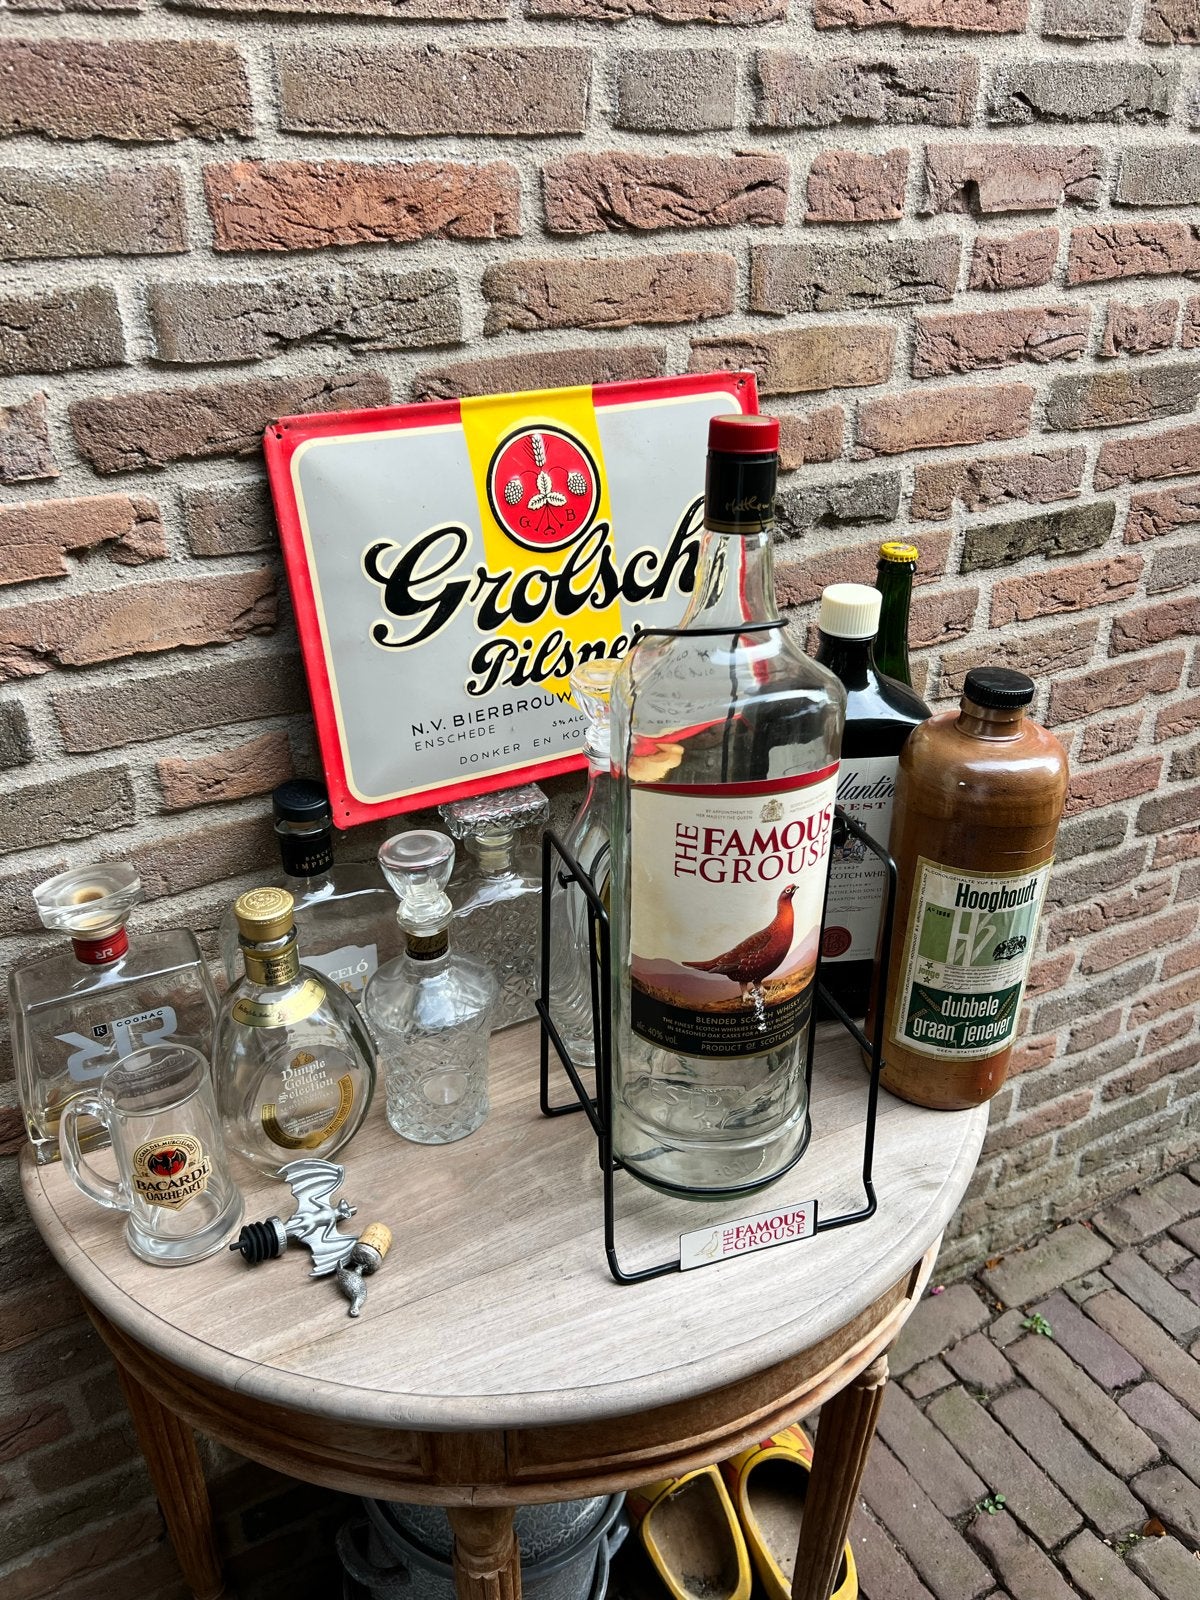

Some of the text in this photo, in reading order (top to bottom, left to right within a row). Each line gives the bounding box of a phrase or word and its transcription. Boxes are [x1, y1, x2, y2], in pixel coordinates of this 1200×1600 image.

[519, 509, 577, 528] G B
[364, 495, 705, 648] Grolsch
[466, 623, 642, 696] Pilsne
[411, 691, 572, 737] N.V. BIERBROUW
[414, 724, 497, 752] ENSCHEDE
[459, 743, 521, 766] DONKER
[532, 736, 551, 748] EN
[701, 802, 832, 857] FAMOUS
[674, 822, 699, 877] THE
[699, 830, 829, 884] GROUSE
[955, 878, 1038, 914] Hooghoudt
[116, 1010, 164, 1028] COGNAC
[695, 1016, 737, 1025] BLENDED
[941, 995, 1000, 1019] dubbele
[701, 1043, 741, 1052] PRODUCT
[760, 1026, 795, 1047] SCOTLAND
[913, 1015, 1012, 1047] graan jenever
[278, 1078, 334, 1105] Selection
[284, 1070, 327, 1091] Golden
[136, 1164, 210, 1192] BACARDI
[145, 1179, 202, 1201] OAKHEART
[734, 1222, 806, 1250] GROUSE
[735, 1209, 806, 1239] FAMOUS
[722, 1228, 734, 1254] THE
